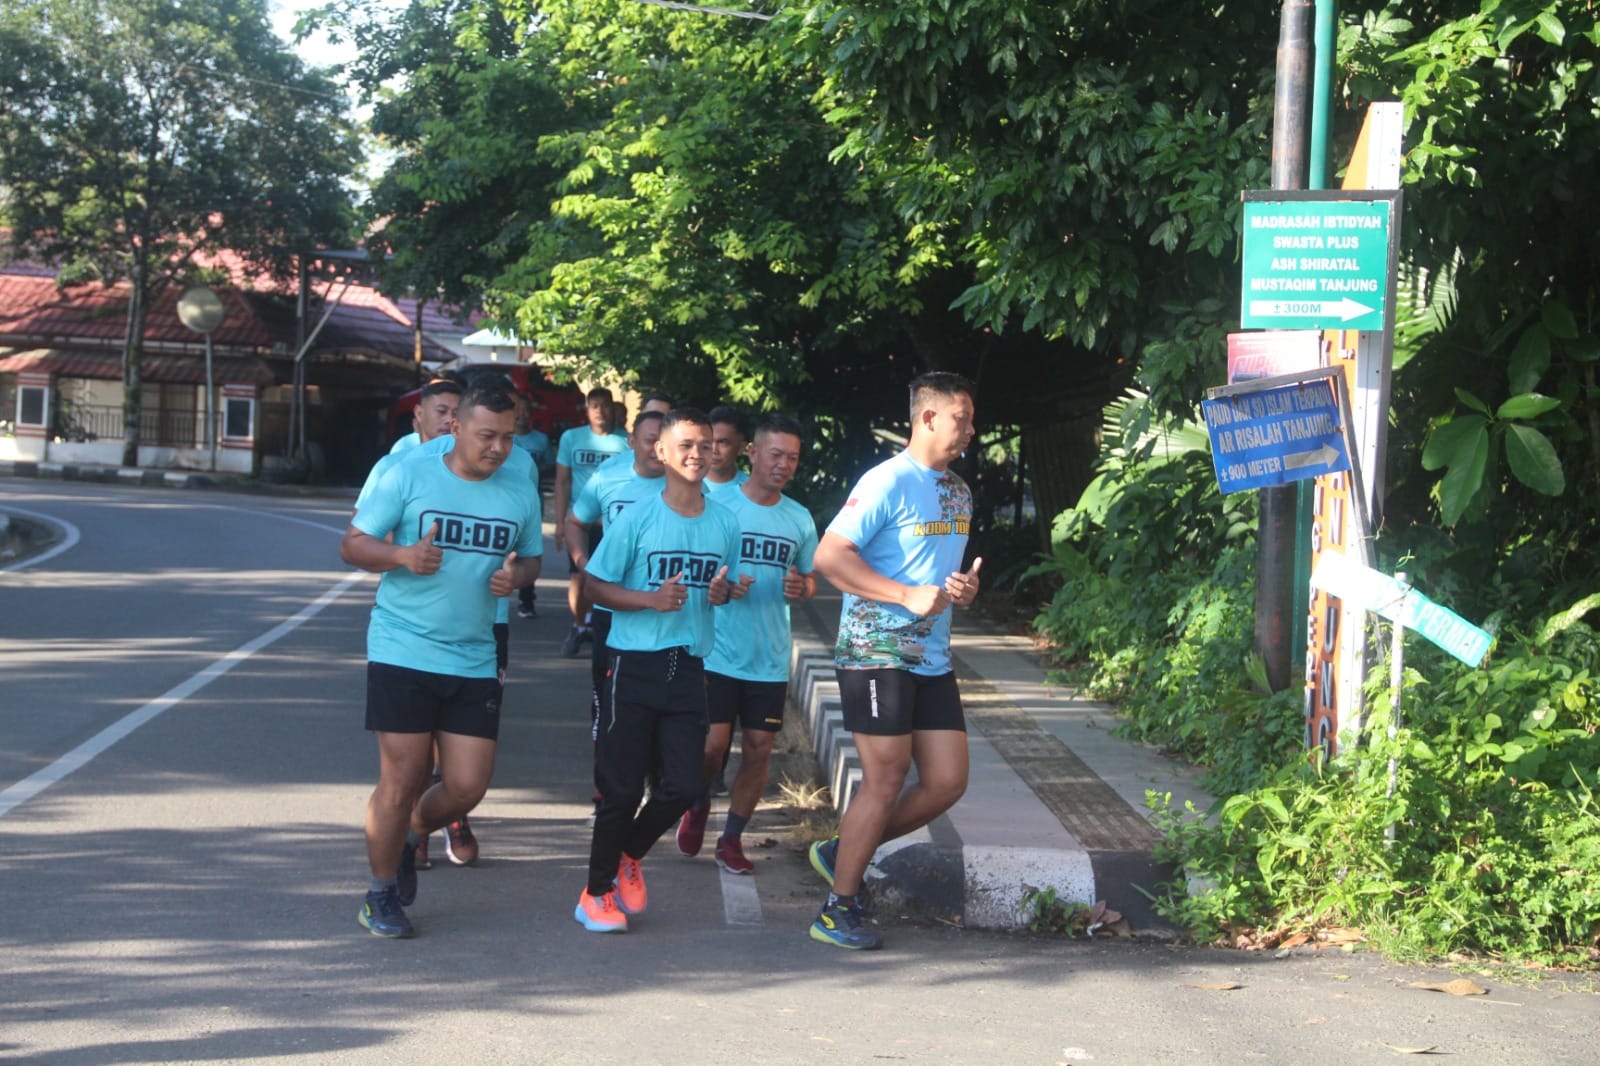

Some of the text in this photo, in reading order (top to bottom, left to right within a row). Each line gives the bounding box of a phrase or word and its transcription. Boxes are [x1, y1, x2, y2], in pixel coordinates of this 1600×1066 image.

[1251, 216, 1382, 229] MADRASAH IBTIDYAH
[1273, 236, 1359, 249] SWASTA PLUS
[1271, 258, 1360, 271] ASH SHIRATAL
[1250, 278, 1378, 292] MUSTAQIM TANJUNG
[1264, 391, 1293, 416] ISLAM
[1218, 430, 1236, 454] AR
[1234, 421, 1285, 450] RISALAH
[1248, 456, 1281, 478] METER
[433, 517, 511, 550] 10:08
[740, 538, 790, 563] 0:08
[658, 557, 718, 583] 10:08
